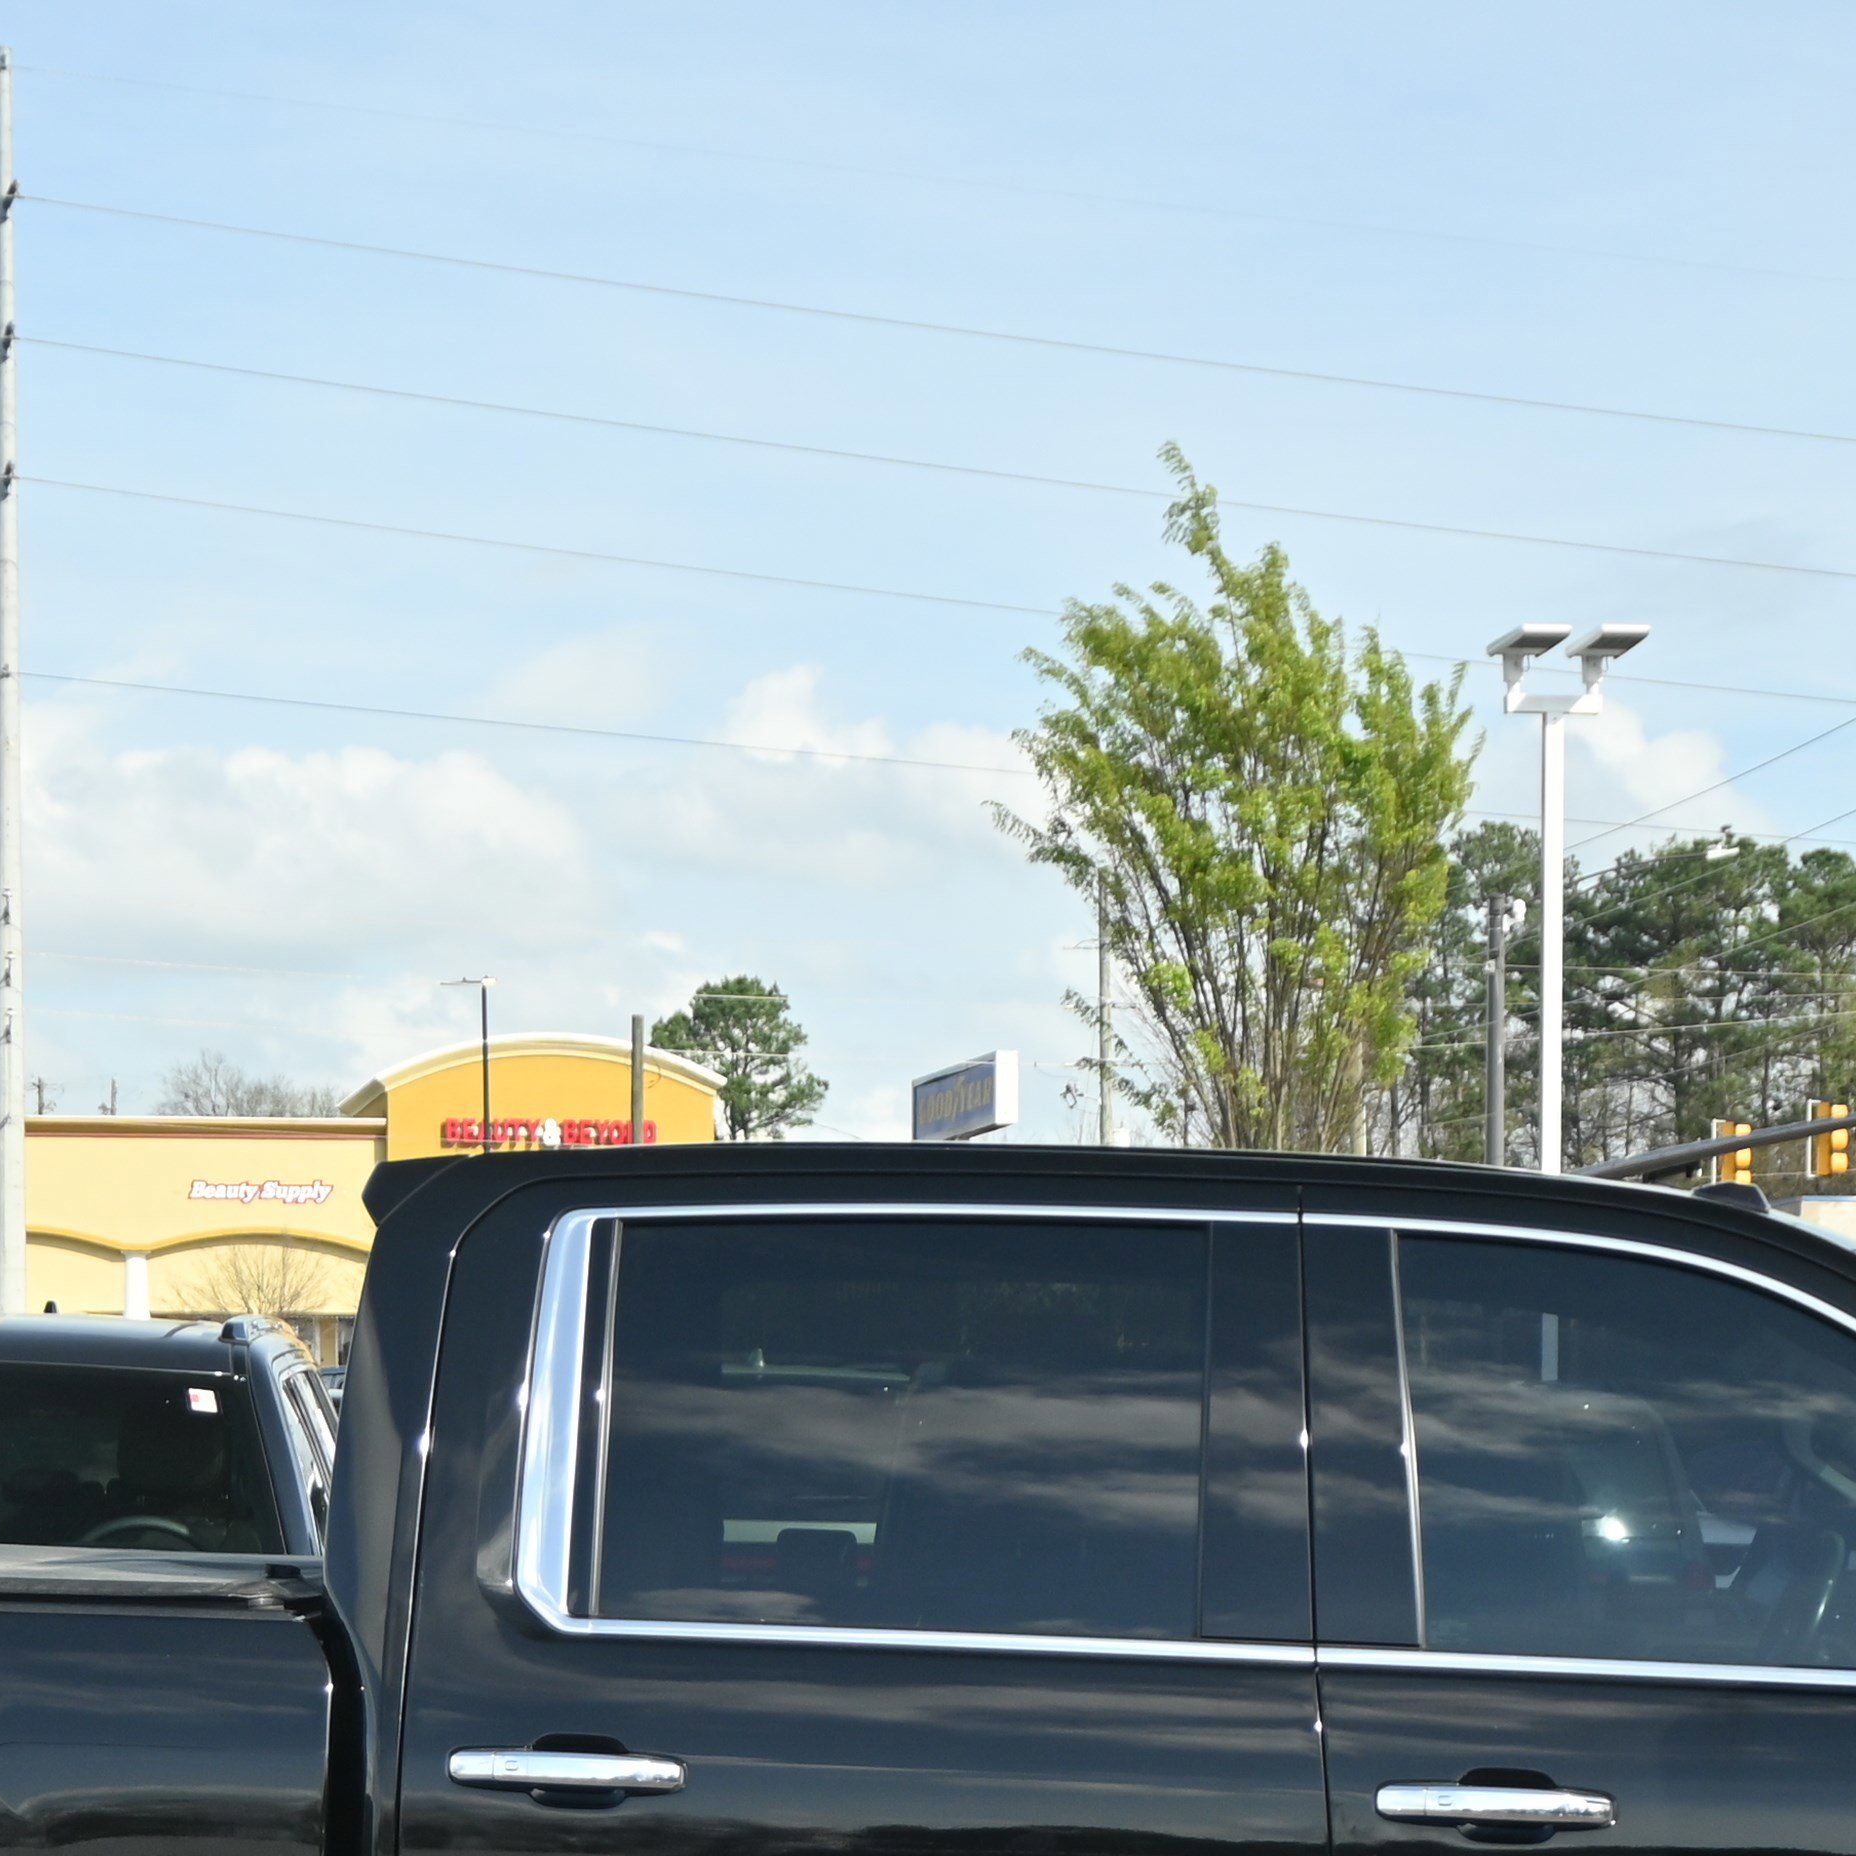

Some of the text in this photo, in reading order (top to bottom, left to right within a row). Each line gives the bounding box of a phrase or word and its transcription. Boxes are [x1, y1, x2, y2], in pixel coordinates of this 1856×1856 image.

[543, 1117, 561, 1146] &
[188, 1179, 334, 1204] Beauty Supply
